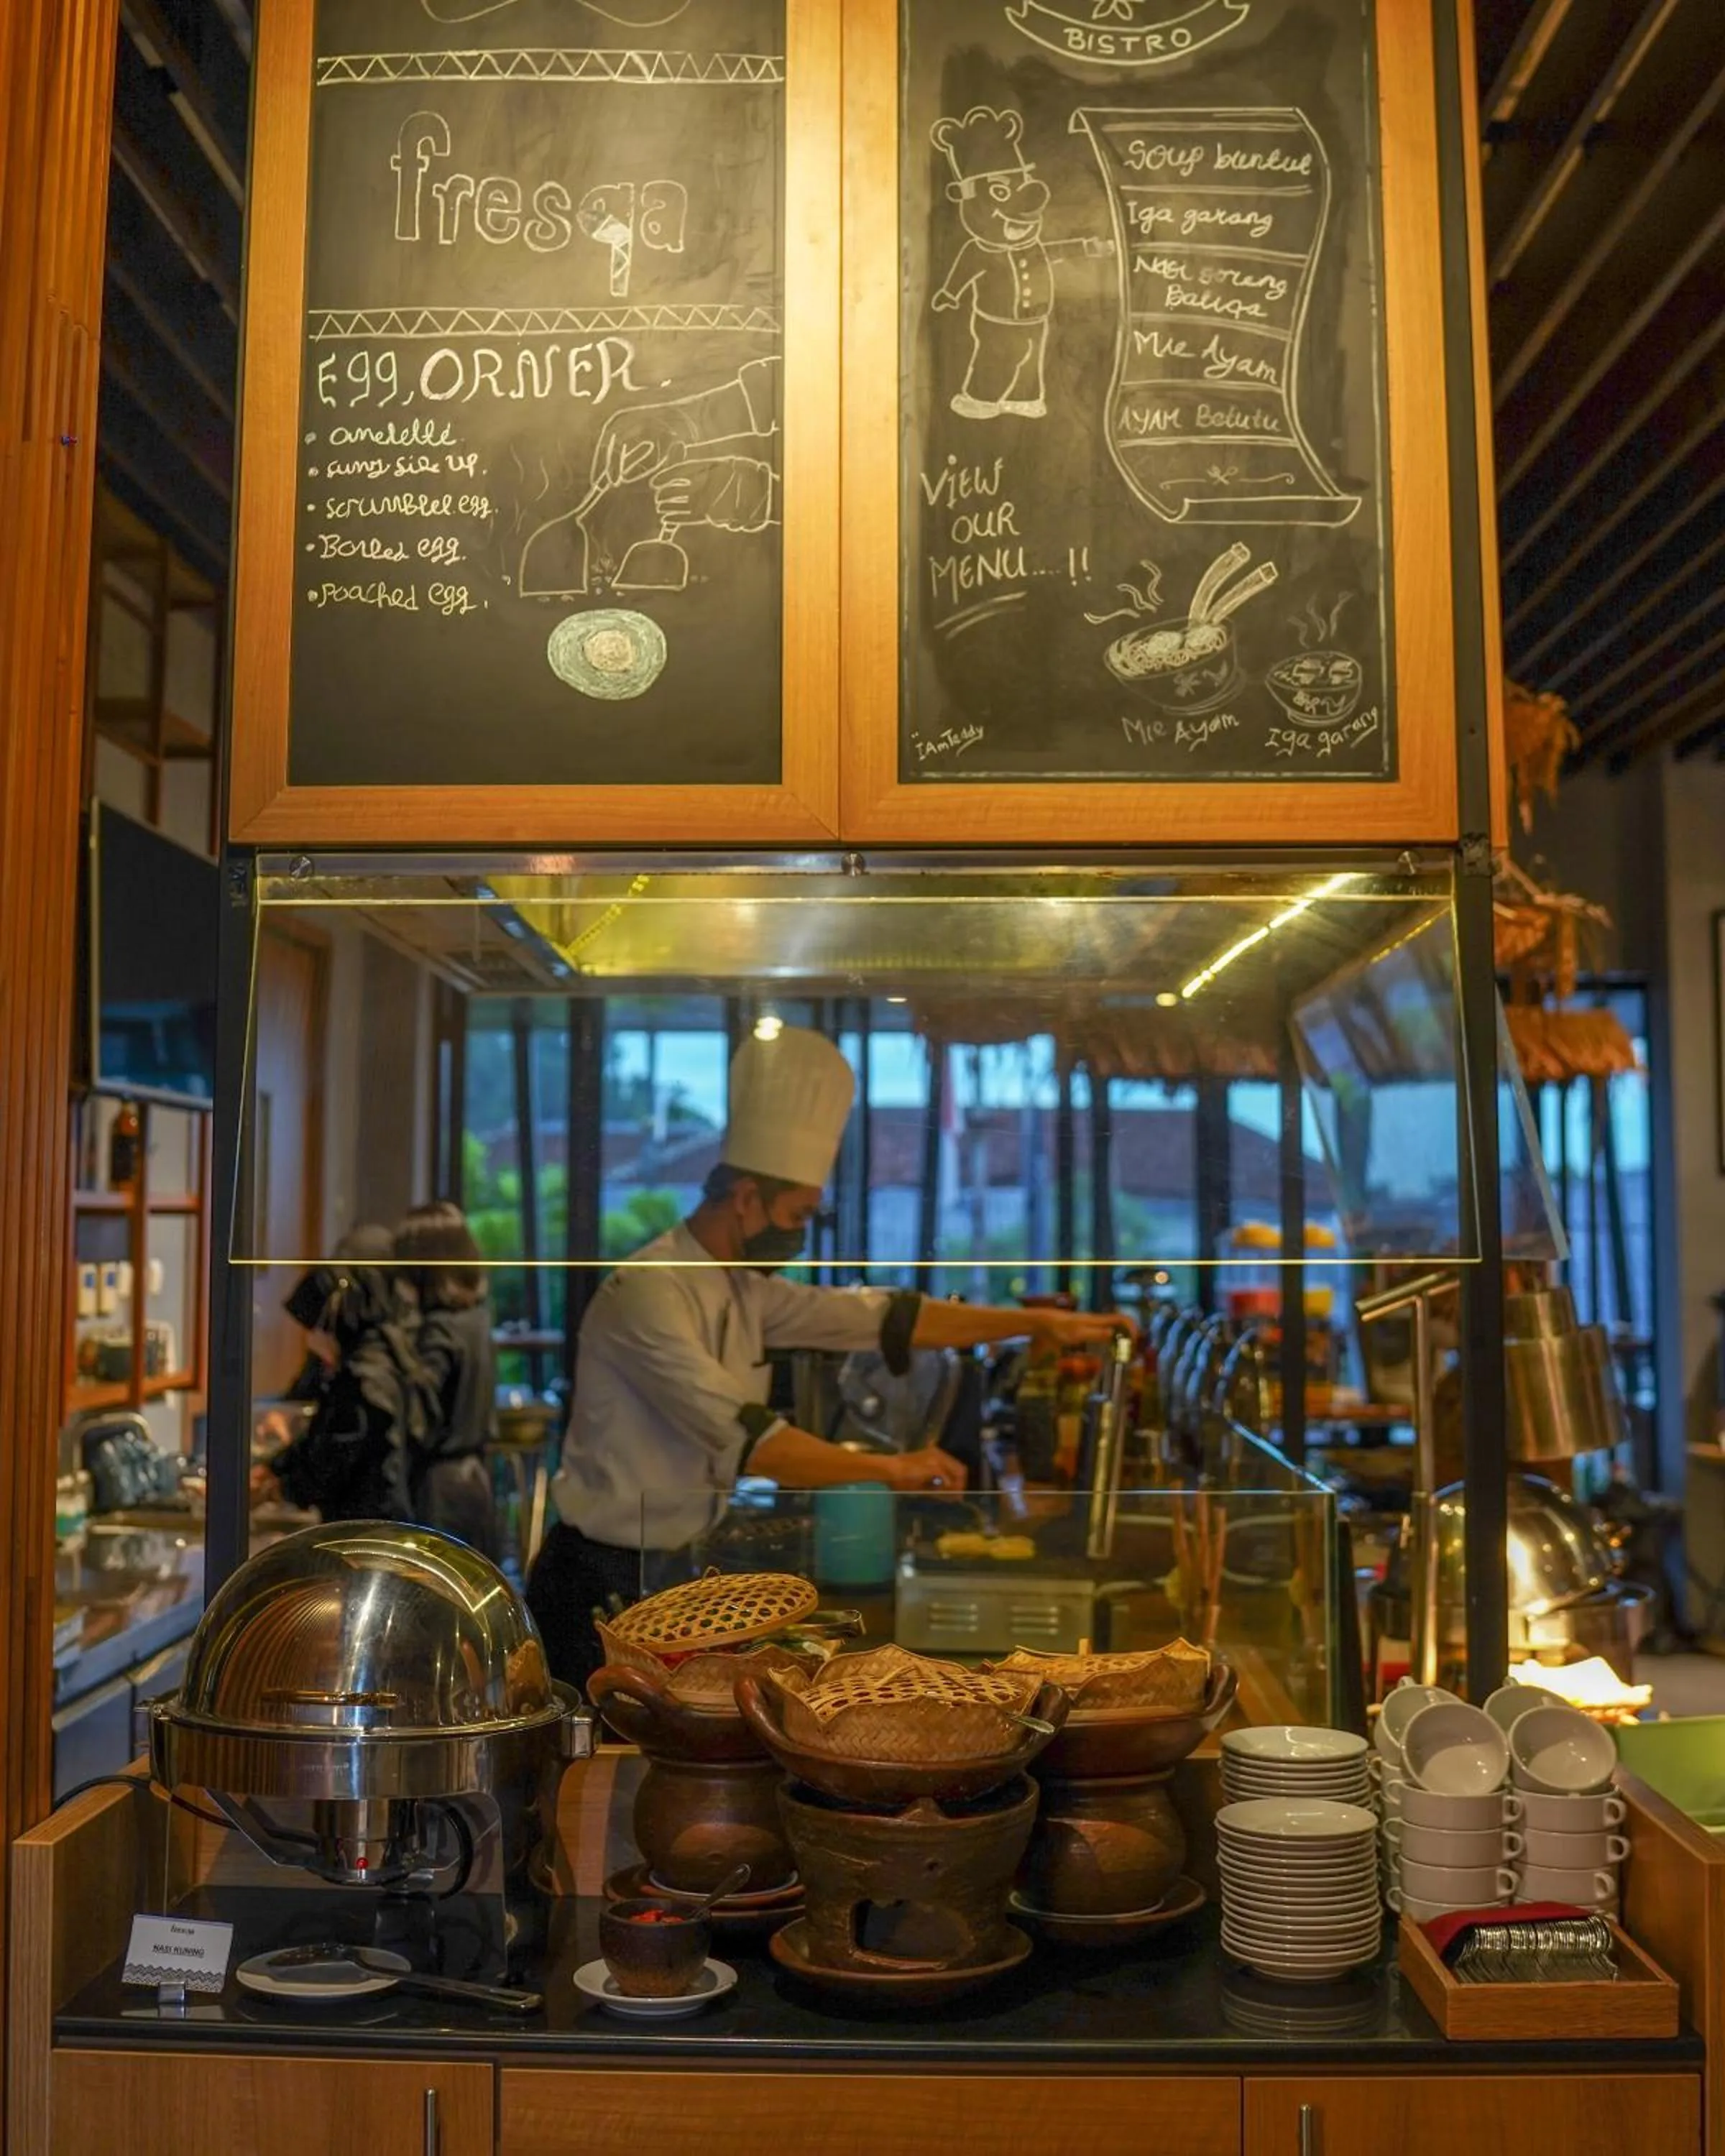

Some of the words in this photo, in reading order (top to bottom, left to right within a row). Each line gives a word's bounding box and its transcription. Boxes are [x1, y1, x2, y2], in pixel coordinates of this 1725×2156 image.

[1063, 27, 1192, 55] BISTRO
[390, 110, 688, 296] fresqa
[1126, 201, 1174, 234] Iga
[1133, 330, 1196, 358] Mie
[1200, 333, 1277, 384] Ayam
[1195, 403, 1282, 432] Betutu
[951, 501, 1021, 544] OUR
[1121, 717, 1167, 745] Mie
[1174, 713, 1240, 752] Ayam
[1265, 727, 1312, 757] Iga
